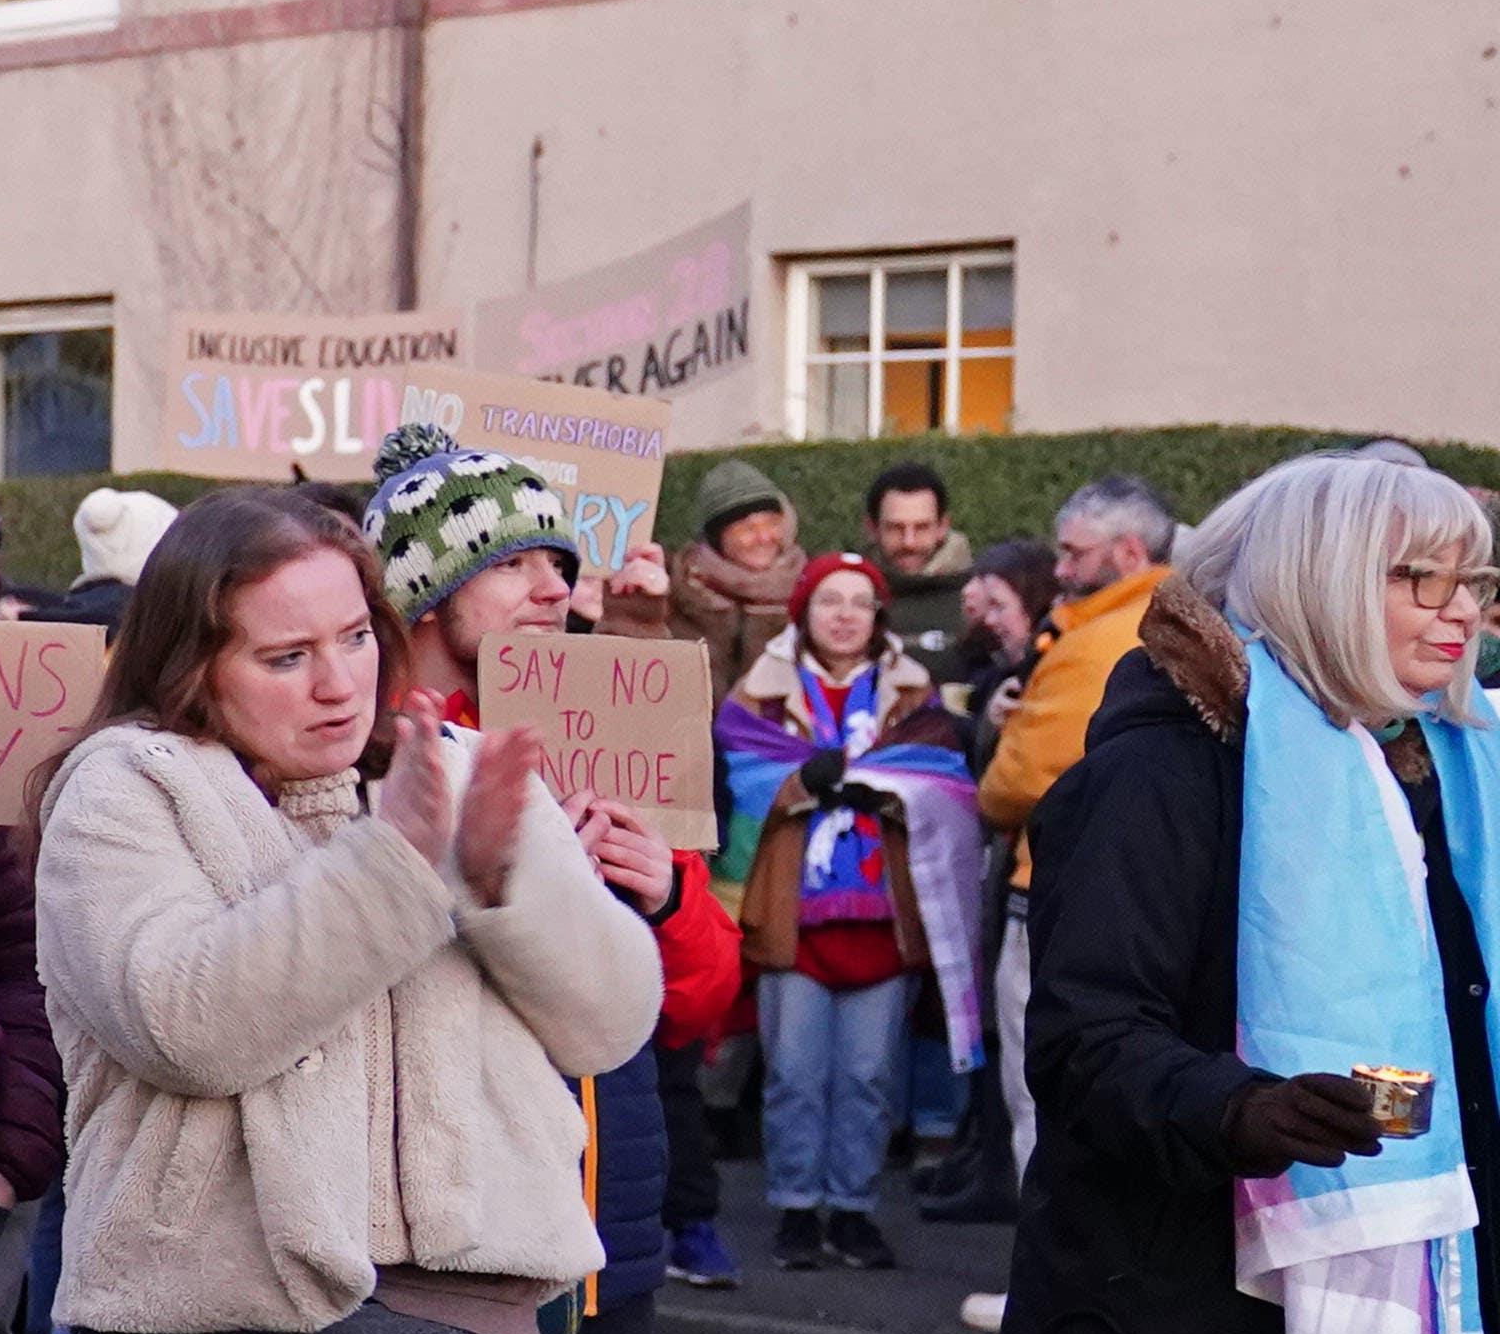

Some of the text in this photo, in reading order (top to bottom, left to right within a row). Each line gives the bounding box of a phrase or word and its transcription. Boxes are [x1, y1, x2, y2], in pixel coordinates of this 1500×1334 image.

[188, 327, 457, 368] INCLUSIVE EDUCATION
[639, 298, 750, 395] AGAIN
[481, 405, 663, 459] TRANSPHOBIA
[498, 645, 670, 707] SAY NO
[559, 709, 595, 741] TO
[538, 745, 677, 805] NOCIDE
